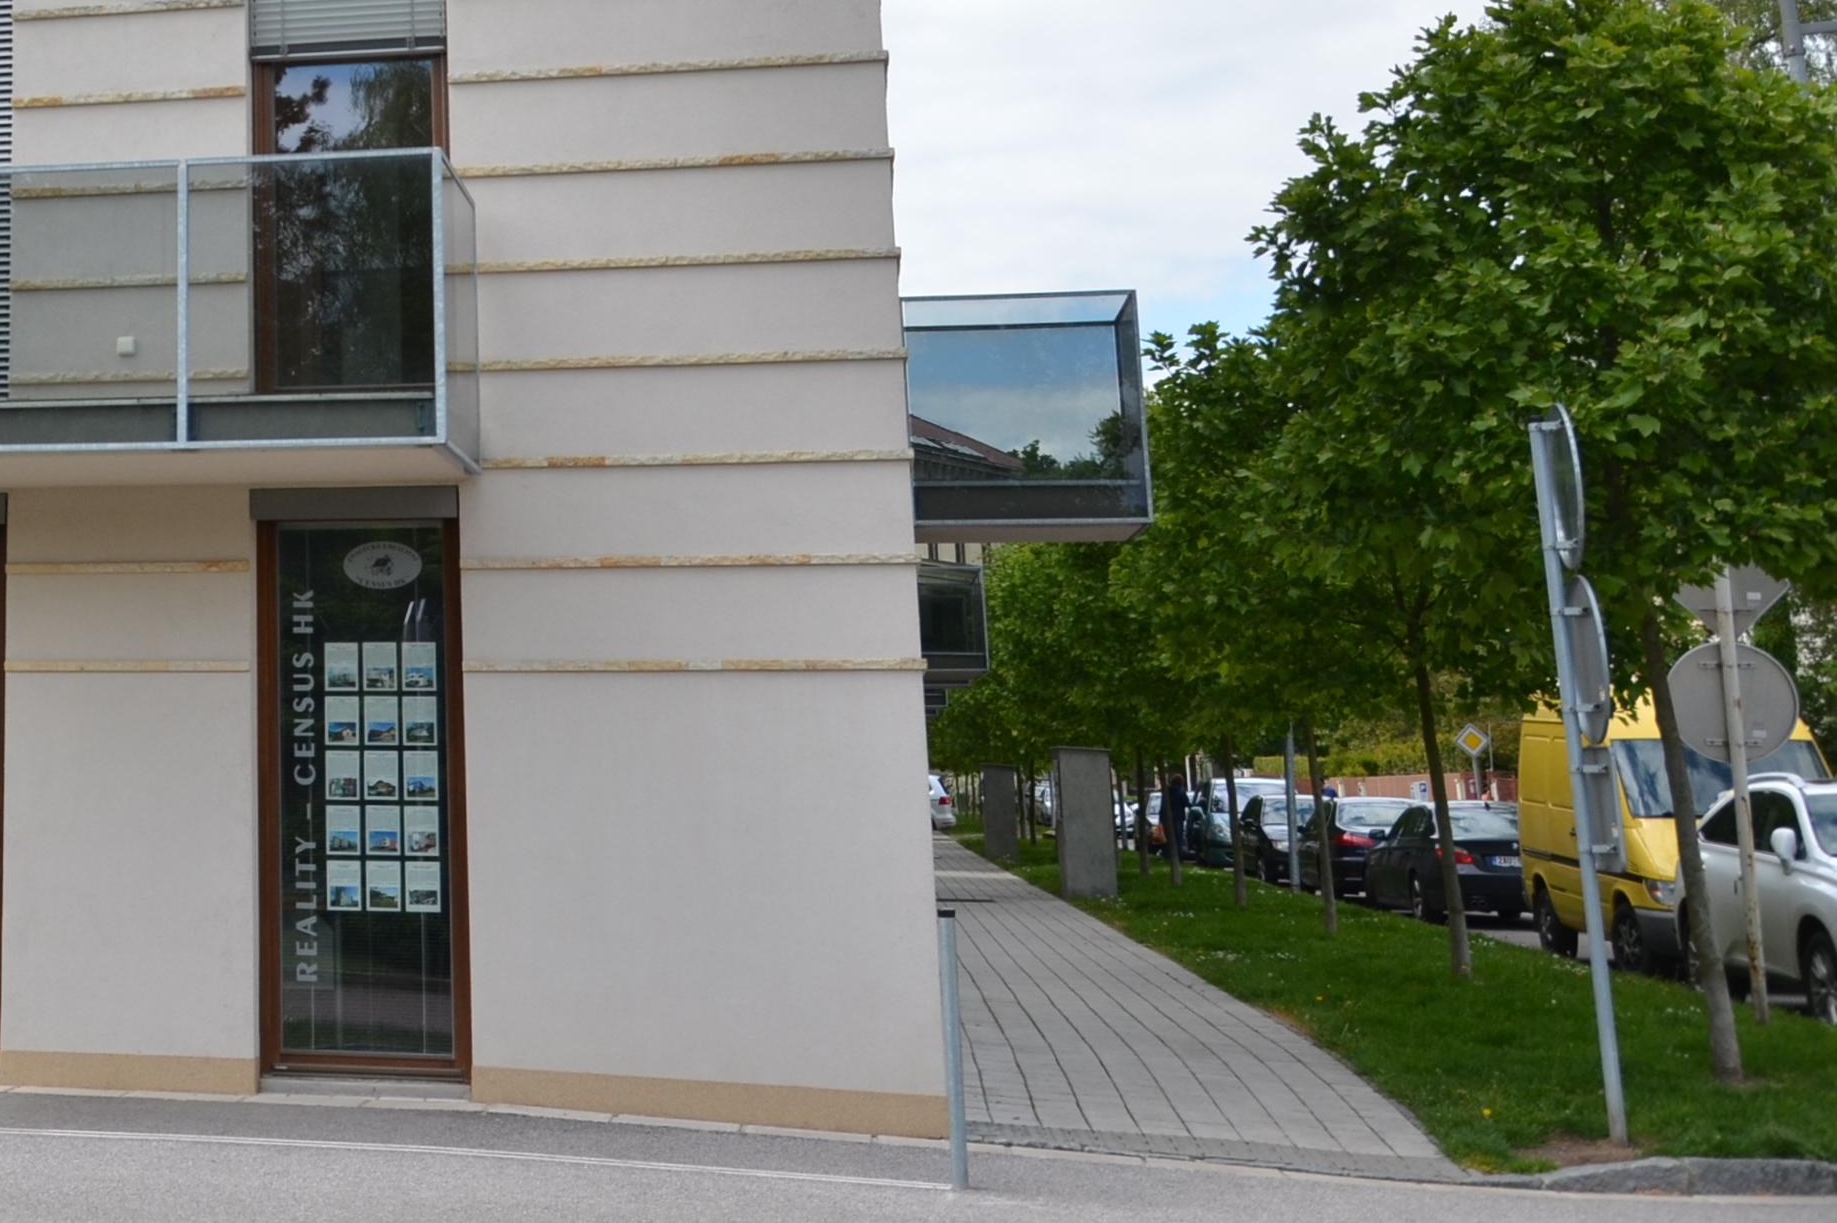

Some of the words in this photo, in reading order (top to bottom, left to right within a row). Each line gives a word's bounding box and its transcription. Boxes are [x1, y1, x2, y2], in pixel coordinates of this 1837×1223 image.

[292, 589, 314, 634] HK
[292, 652, 316, 786] CENSUS
[295, 836, 318, 982] REALITY
